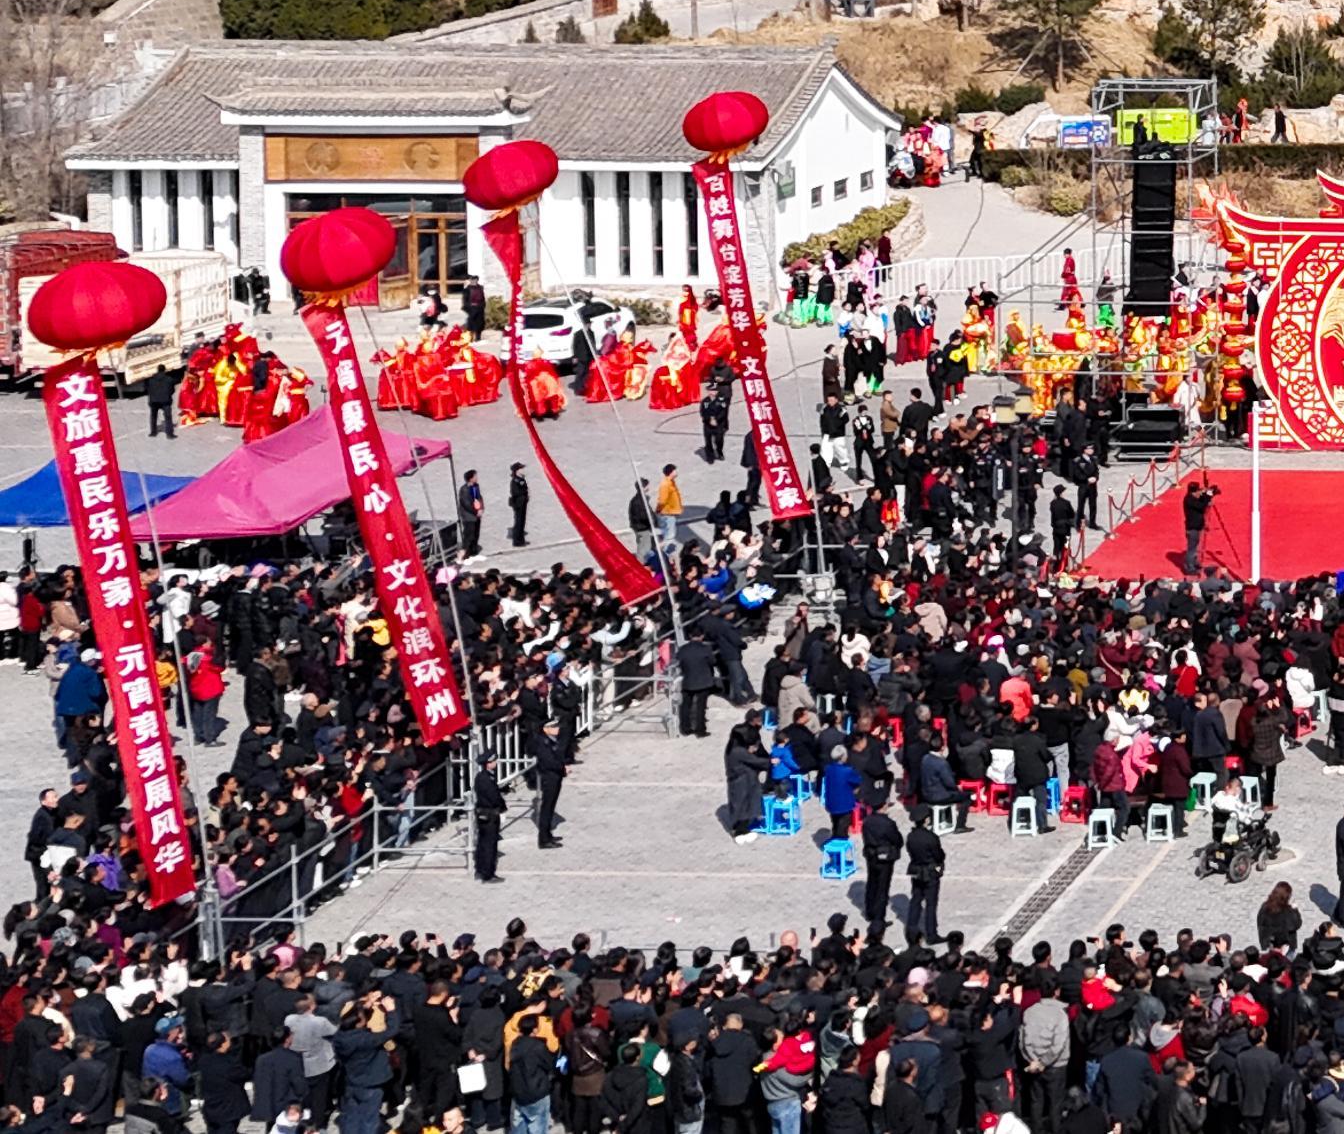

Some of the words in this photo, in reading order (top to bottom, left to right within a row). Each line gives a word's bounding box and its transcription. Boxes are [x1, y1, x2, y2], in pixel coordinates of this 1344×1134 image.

[56, 374, 185, 876] 文旅惠民乐万家·元宵竞秀展风华
[324, 320, 458, 728] 元宵聚民心·文化润环州
